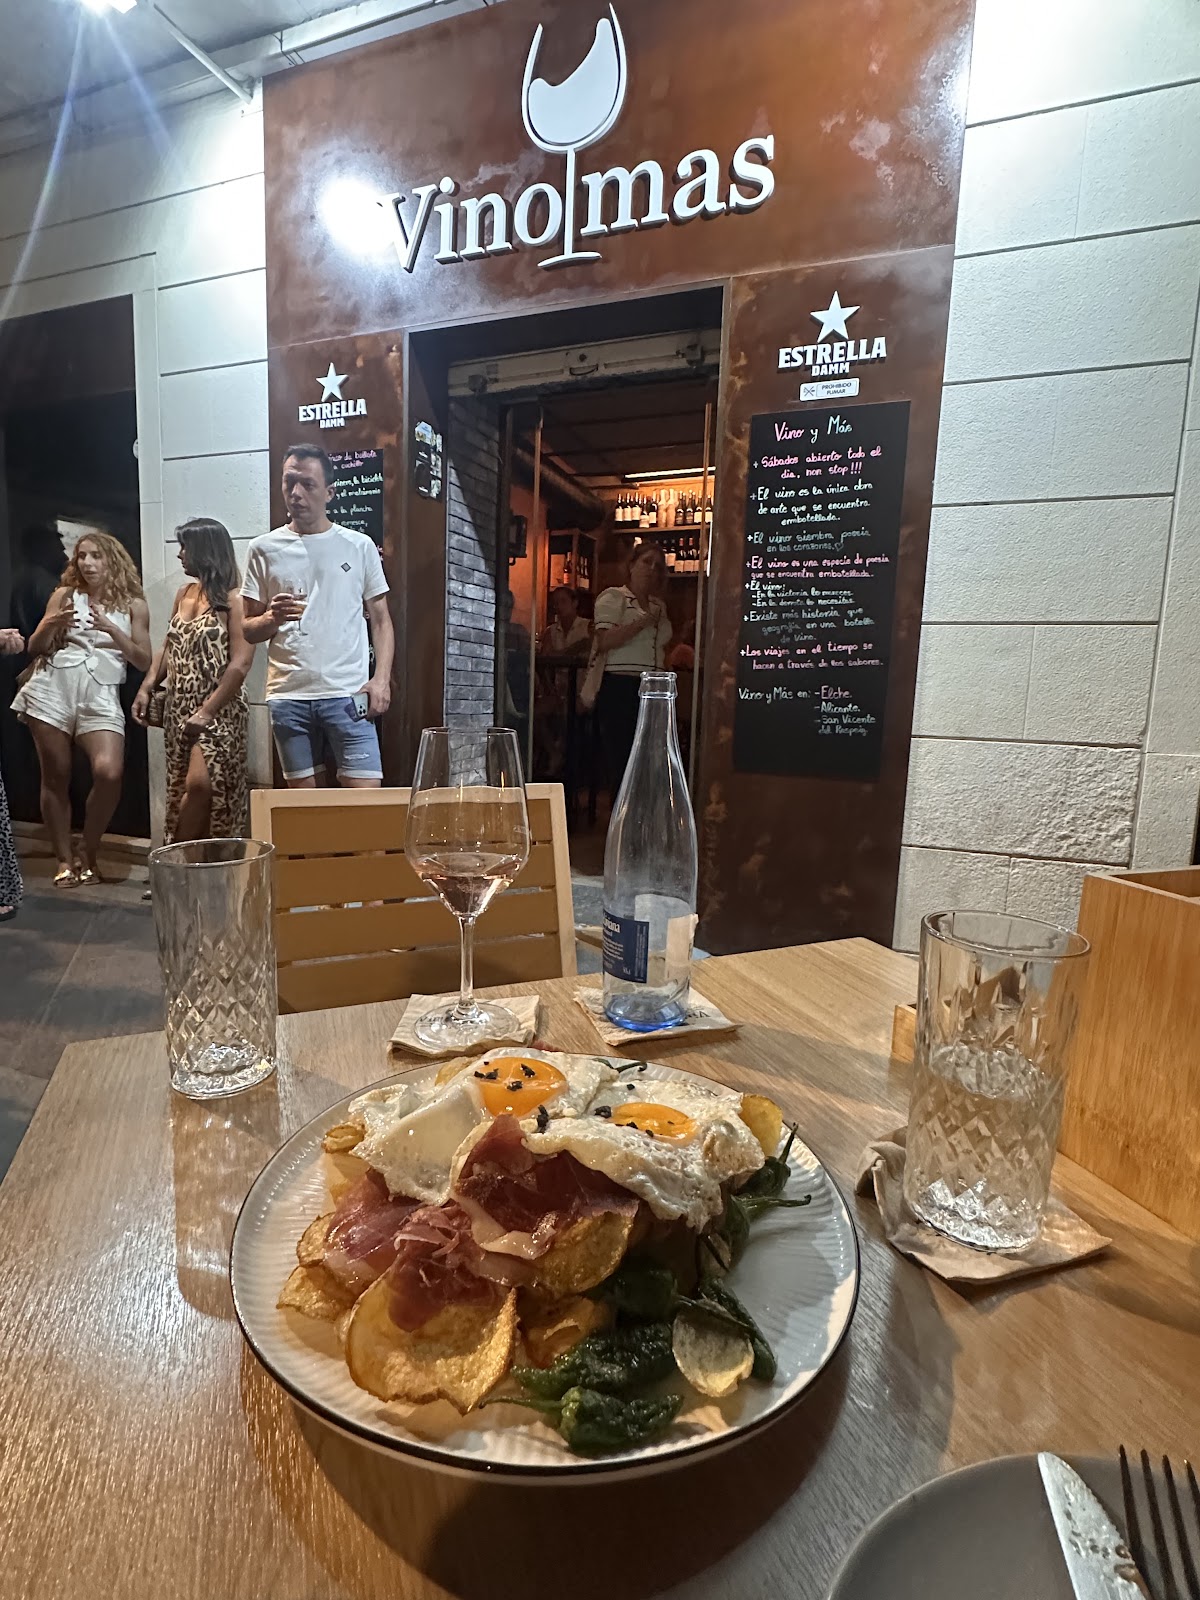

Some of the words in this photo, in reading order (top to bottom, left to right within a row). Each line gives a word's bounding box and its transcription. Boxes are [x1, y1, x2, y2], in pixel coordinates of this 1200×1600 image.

[778, 337, 887, 369] ESTRELLA
[812, 362, 850, 377] DAMM
[299, 399, 367, 422] ESTRELLA
[320, 417, 345, 429] DAMM
[775, 422, 804, 441] Vino
[811, 429, 818, 443] y
[827, 415, 852, 434] Más
[761, 456, 799, 467] Sábados
[806, 450, 842, 463] abierto
[848, 447, 865, 459] todo
[870, 446, 882, 456] el
[341, 460, 364, 469] cuchillo
[806, 468, 822, 476] non
[775, 487, 795, 498] vino
[799, 488, 809, 496] es
[813, 486, 823, 495] la
[827, 484, 849, 493] única
[854, 479, 873, 491] obra
[350, 504, 374, 516] plancha
[758, 503, 768, 515] de
[770, 503, 788, 514] arte
[792, 506, 807, 516] que
[813, 503, 822, 511] se
[828, 498, 870, 510] encuentra
[769, 532, 792, 543] vino
[796, 530, 834, 542] siembra
[779, 544, 791, 552] los
[768, 558, 789, 569] vino
[803, 559, 819, 567] una
[854, 553, 863, 564] de
[751, 572, 764, 580] que
[778, 568, 814, 578] encuentra
[777, 589, 809, 598] victoria
[811, 587, 821, 596] lo
[802, 607, 841, 619] historia
[847, 608, 864, 618] que
[844, 618, 875, 627] botella
[780, 635, 791, 644] de
[764, 646, 790, 657] viajes
[812, 645, 822, 654] el
[828, 641, 858, 655] tiempo
[753, 660, 775, 670] hacen
[818, 659, 828, 668] de
[739, 688, 764, 700] Vino
[766, 694, 772, 704] y
[774, 687, 793, 700] Más
[842, 714, 876, 724] Vicente
